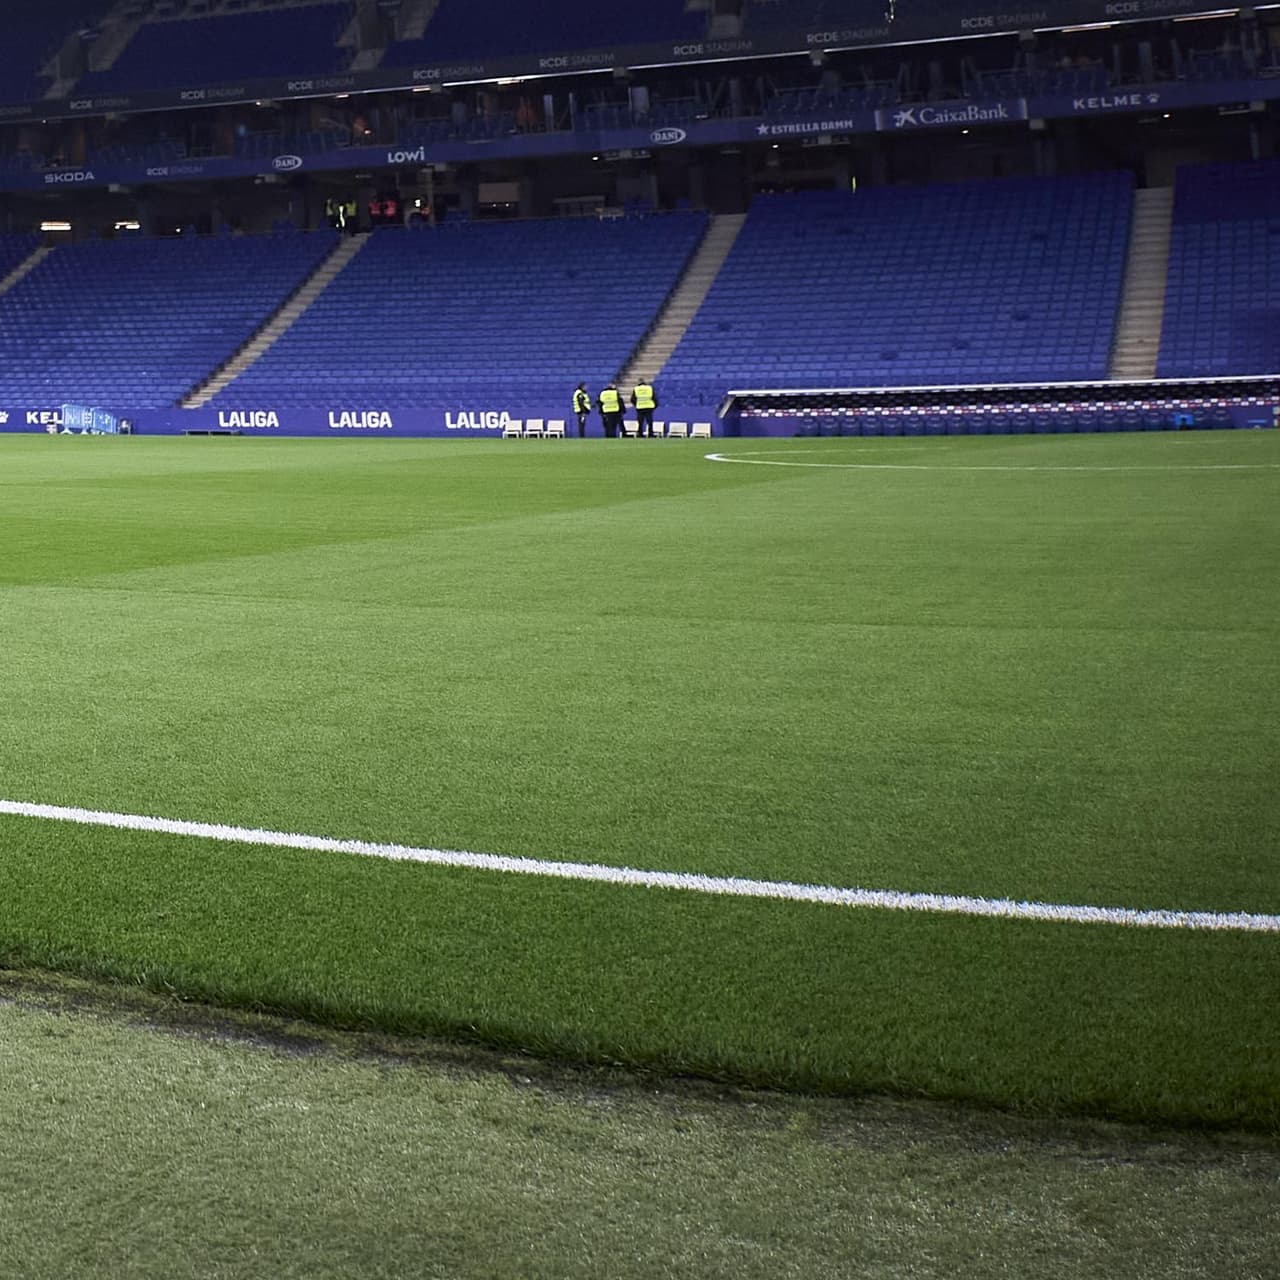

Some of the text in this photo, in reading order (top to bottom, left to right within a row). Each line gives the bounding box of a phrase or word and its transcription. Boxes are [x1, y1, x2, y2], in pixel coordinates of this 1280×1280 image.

[1106, 1, 1140, 15] RCDE
[961, 15, 994, 28] RCDE
[807, 31, 838, 44] RCDE
[674, 43, 704, 57] RCDE
[540, 52, 615, 68] RCDE STADIUM
[413, 68, 440, 80] RCDE
[288, 80, 313, 91] RCDE
[181, 89, 205, 100] RCDE
[1073, 93, 1141, 110] KELME
[919, 103, 1008, 125] CaixaBank
[771, 120, 853, 135] ESTRELLA DAMM
[655, 130, 679, 144] DANI
[218, 410, 279, 428] LALIGA
[329, 411, 392, 428] LALIGA
[445, 411, 512, 429] LALIGA
